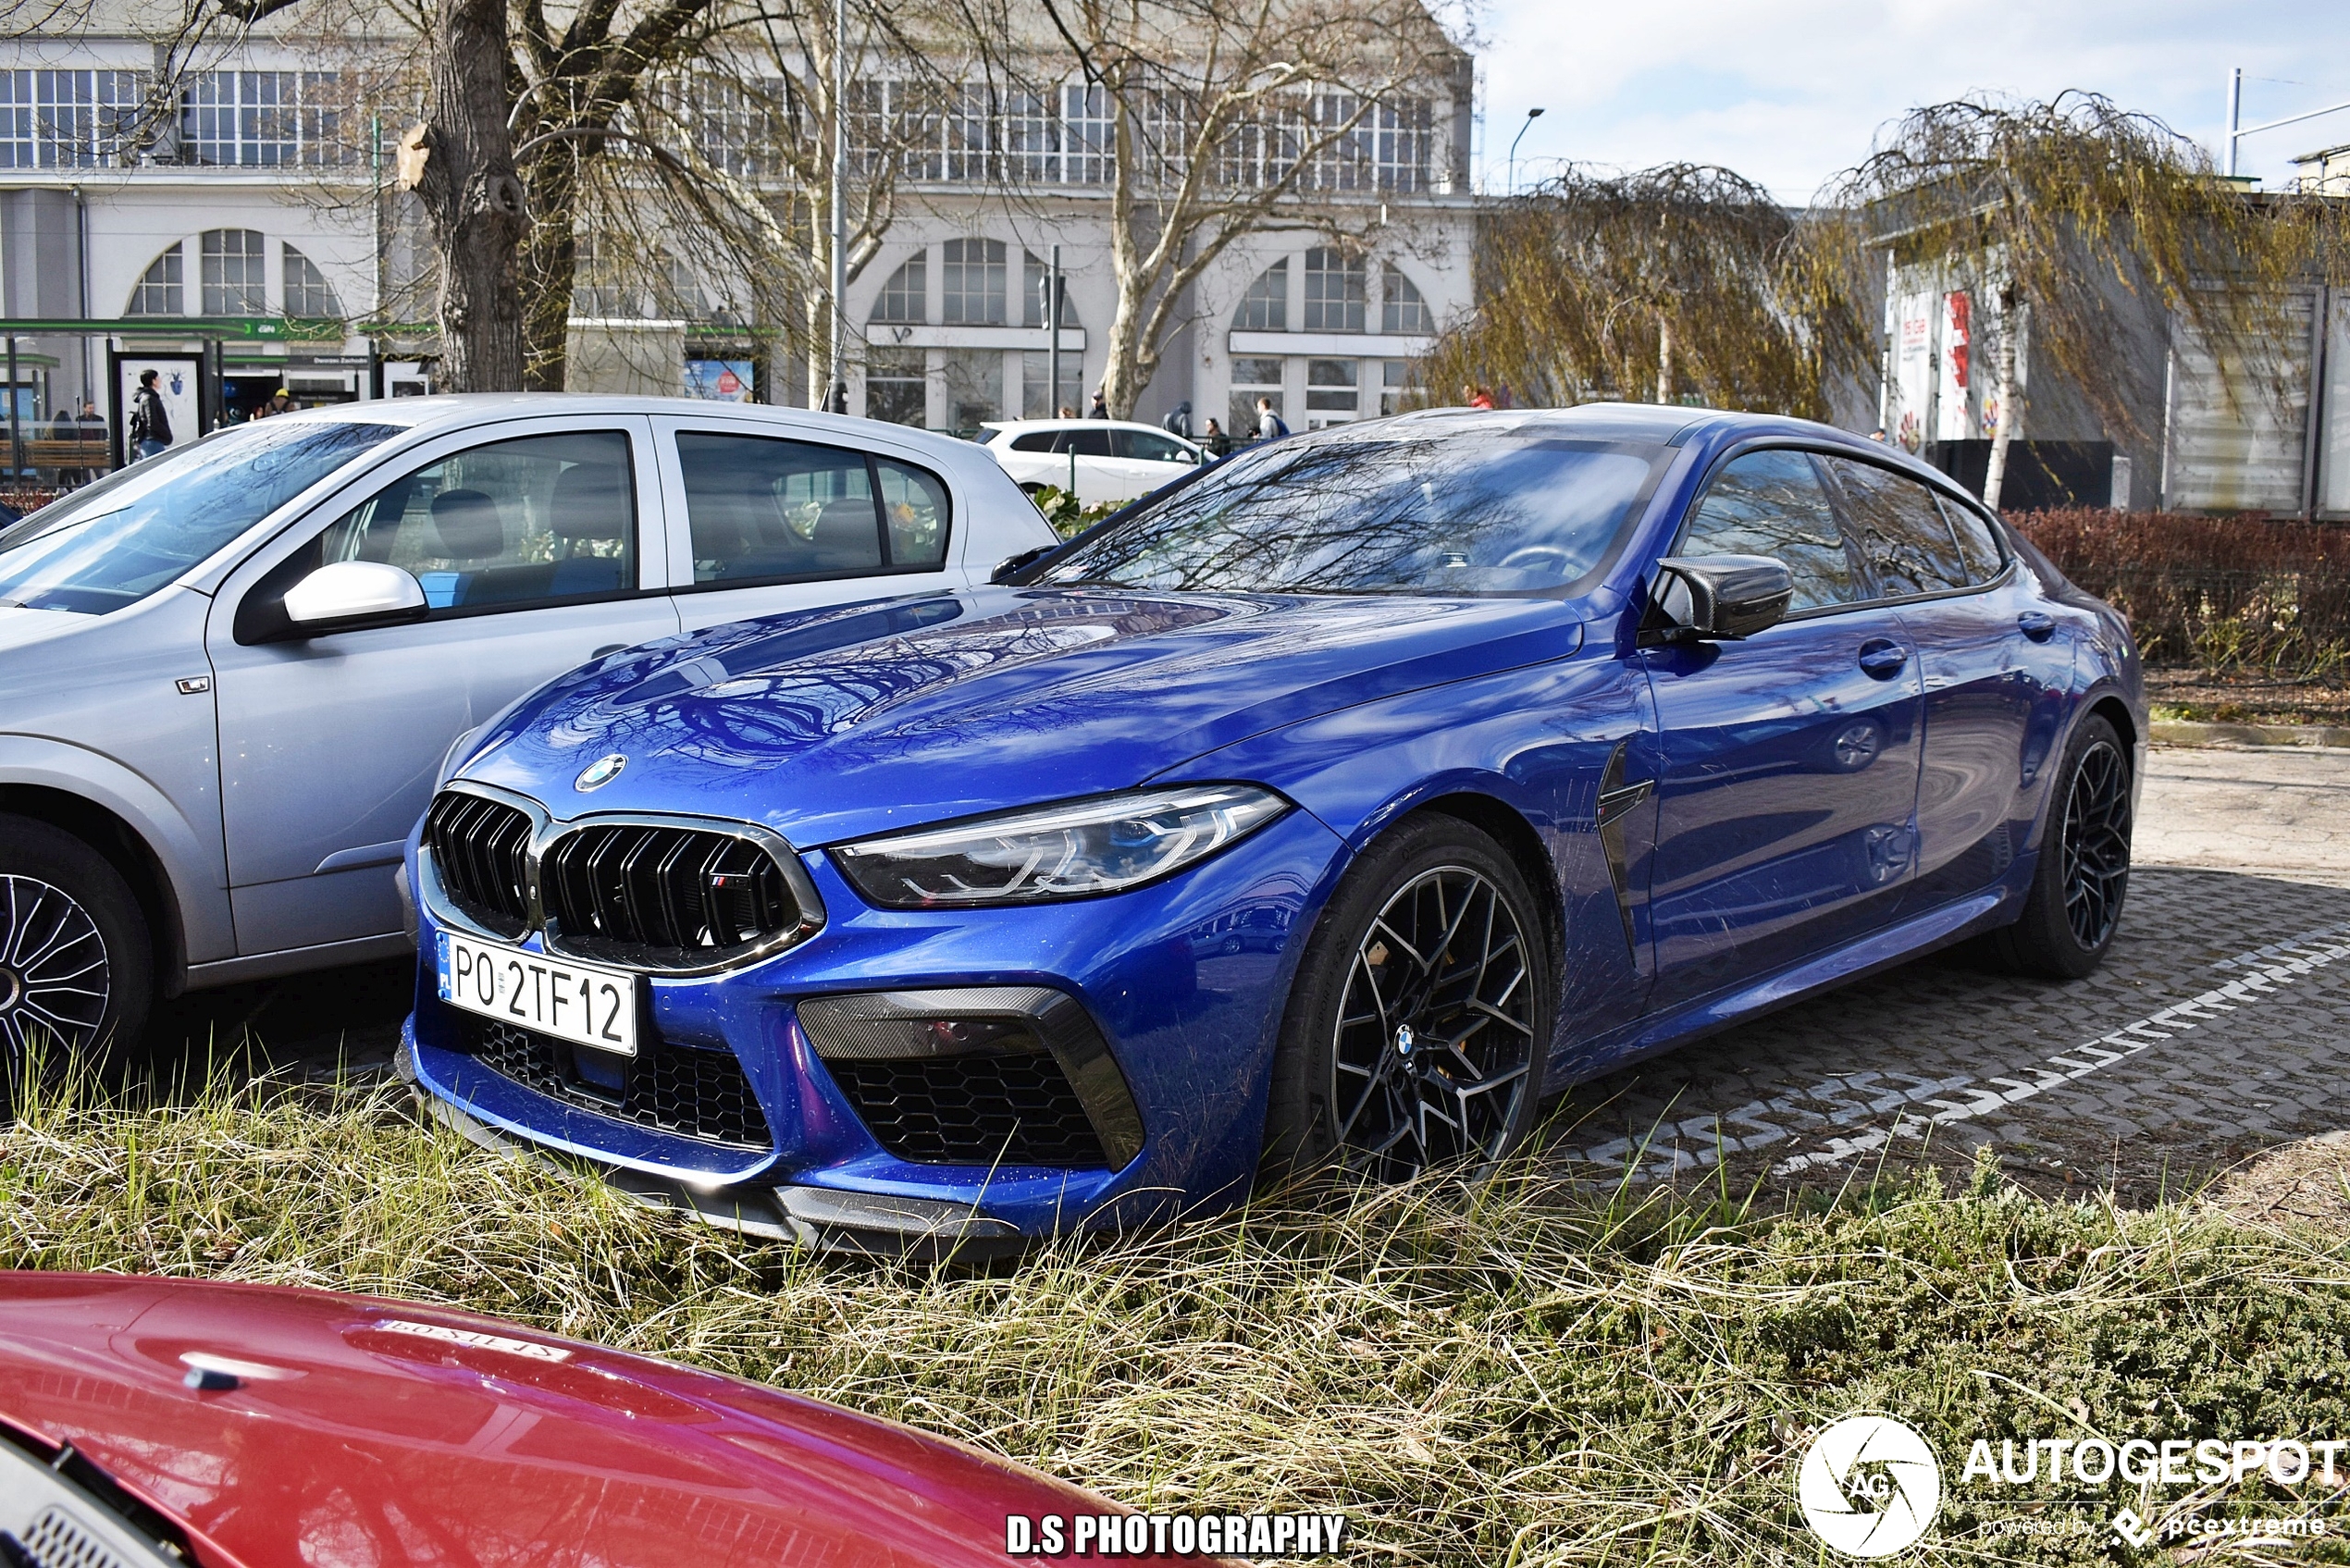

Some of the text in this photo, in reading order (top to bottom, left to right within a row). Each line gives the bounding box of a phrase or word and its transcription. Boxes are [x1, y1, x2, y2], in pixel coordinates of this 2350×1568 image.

[439, 972, 451, 991] PL
[456, 945, 623, 1043] PO 2TF12
